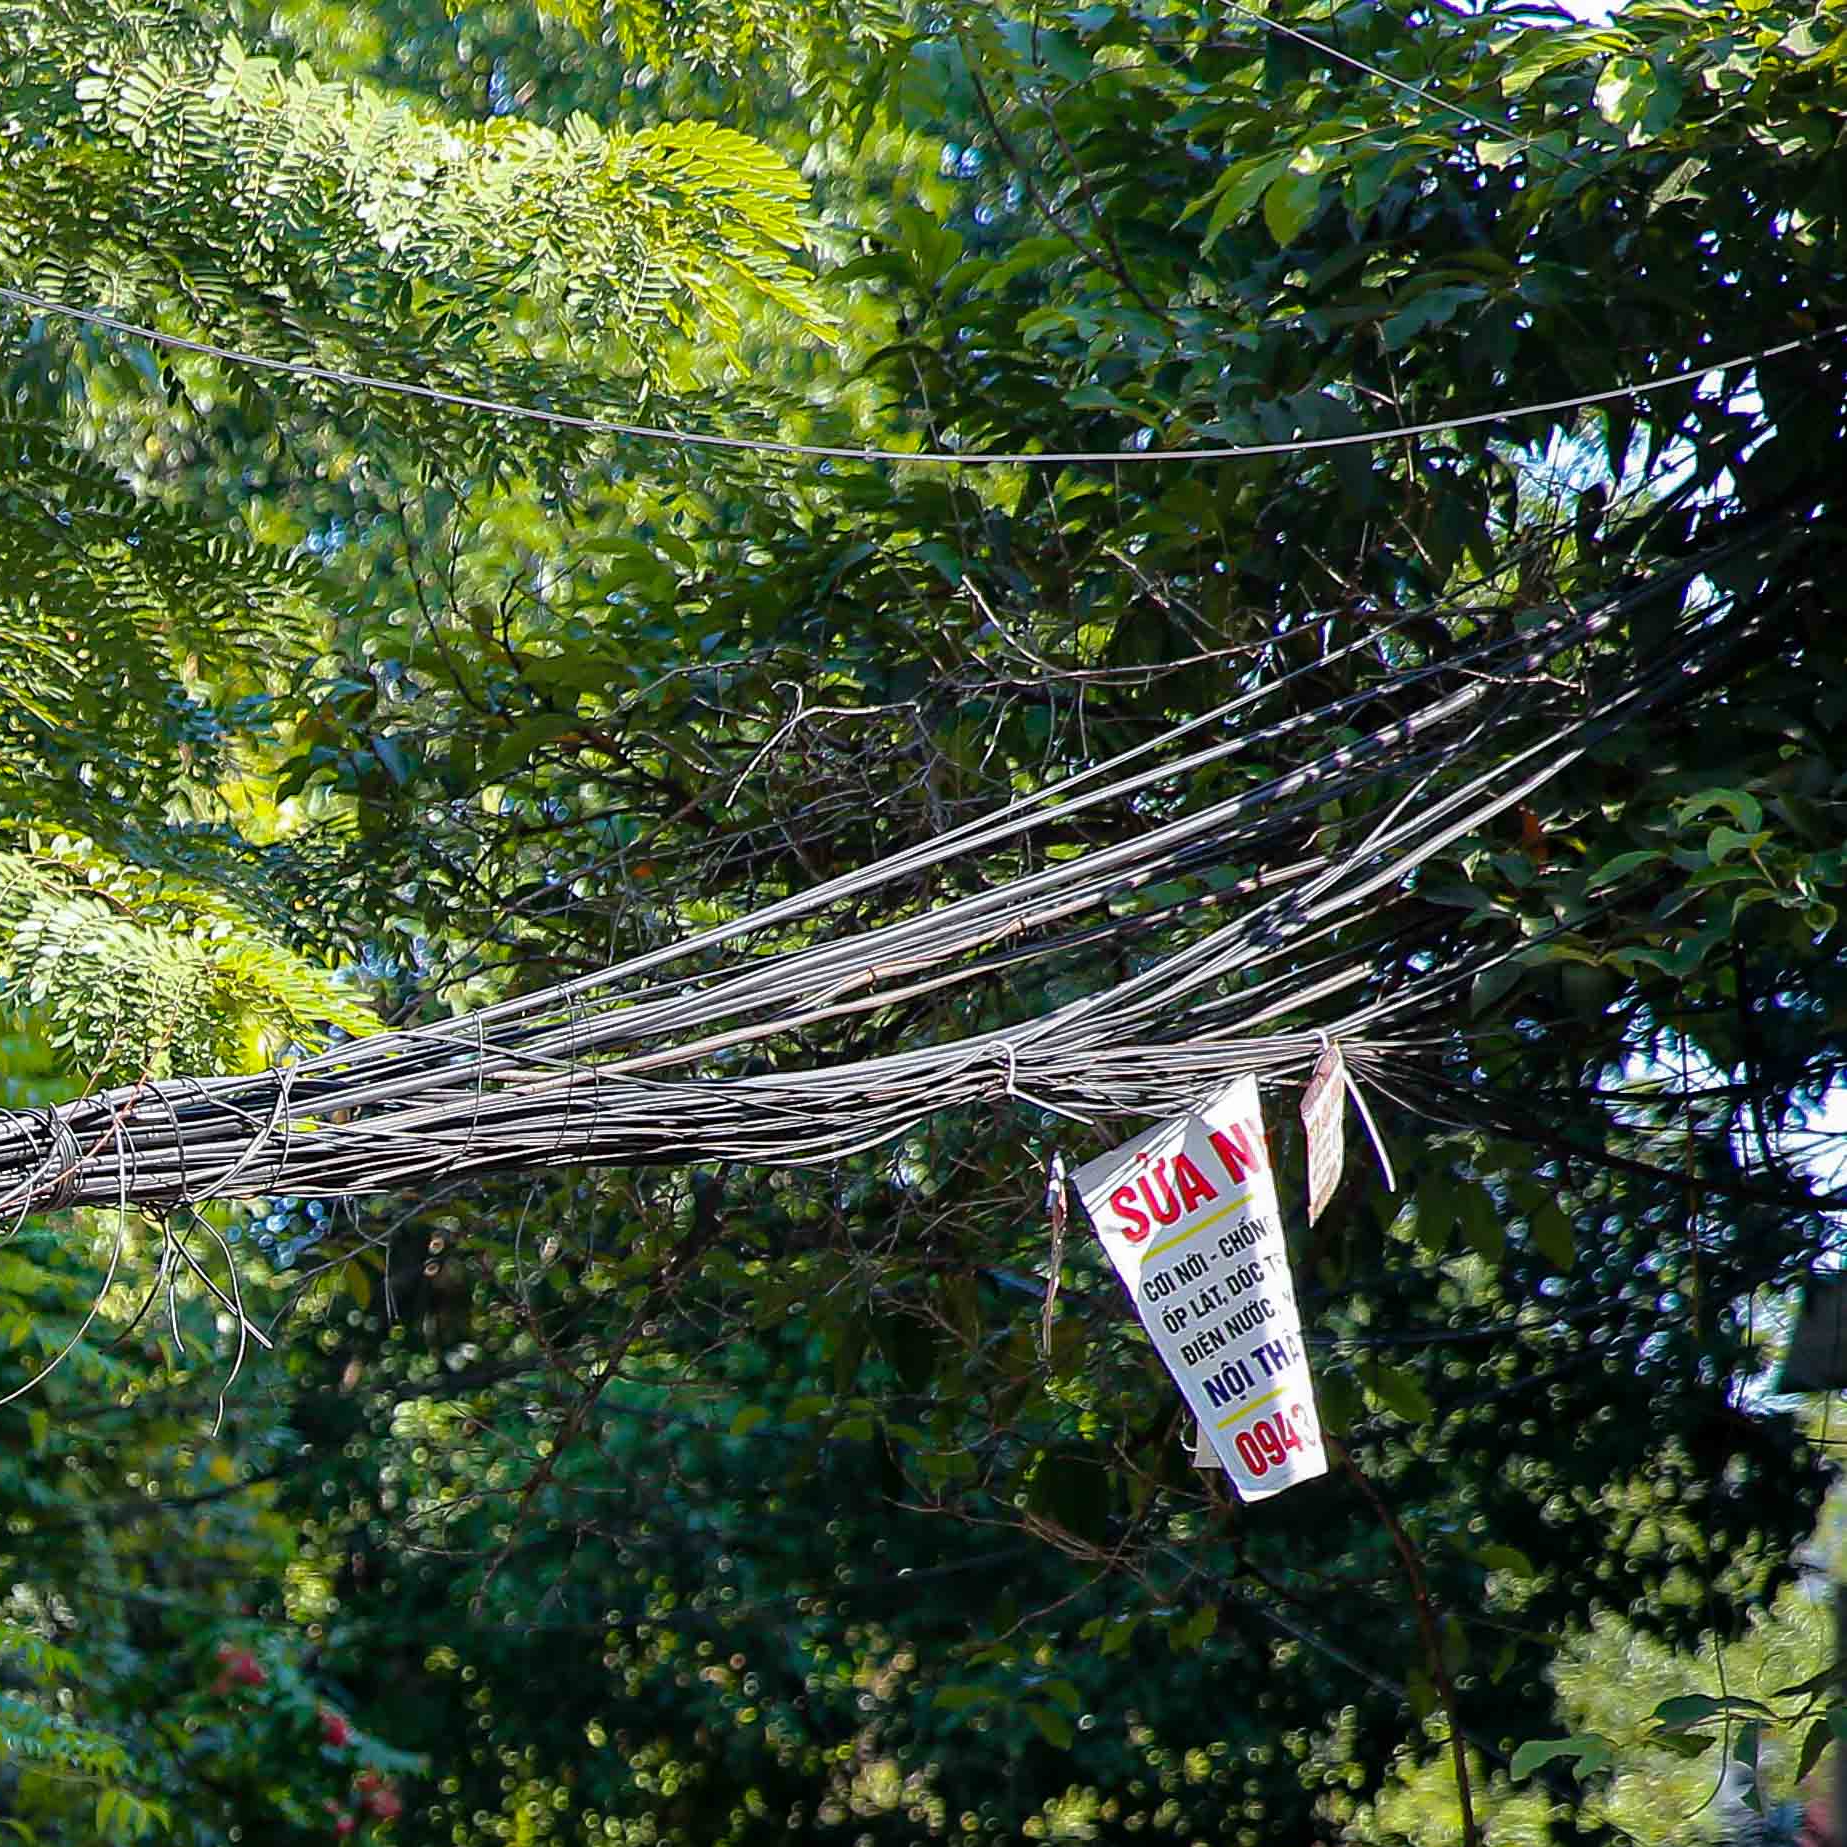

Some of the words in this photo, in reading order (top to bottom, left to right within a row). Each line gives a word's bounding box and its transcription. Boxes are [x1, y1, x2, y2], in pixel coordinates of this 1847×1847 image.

[1109, 1152, 1218, 1243] SỬA
[1209, 1120, 1262, 1184] N
[1174, 1251, 1210, 1287] NỚI
[1162, 1304, 1188, 1334] ỐP
[1180, 1327, 1227, 1366] ĐIỆN
[1202, 1359, 1255, 1408] NỘI
